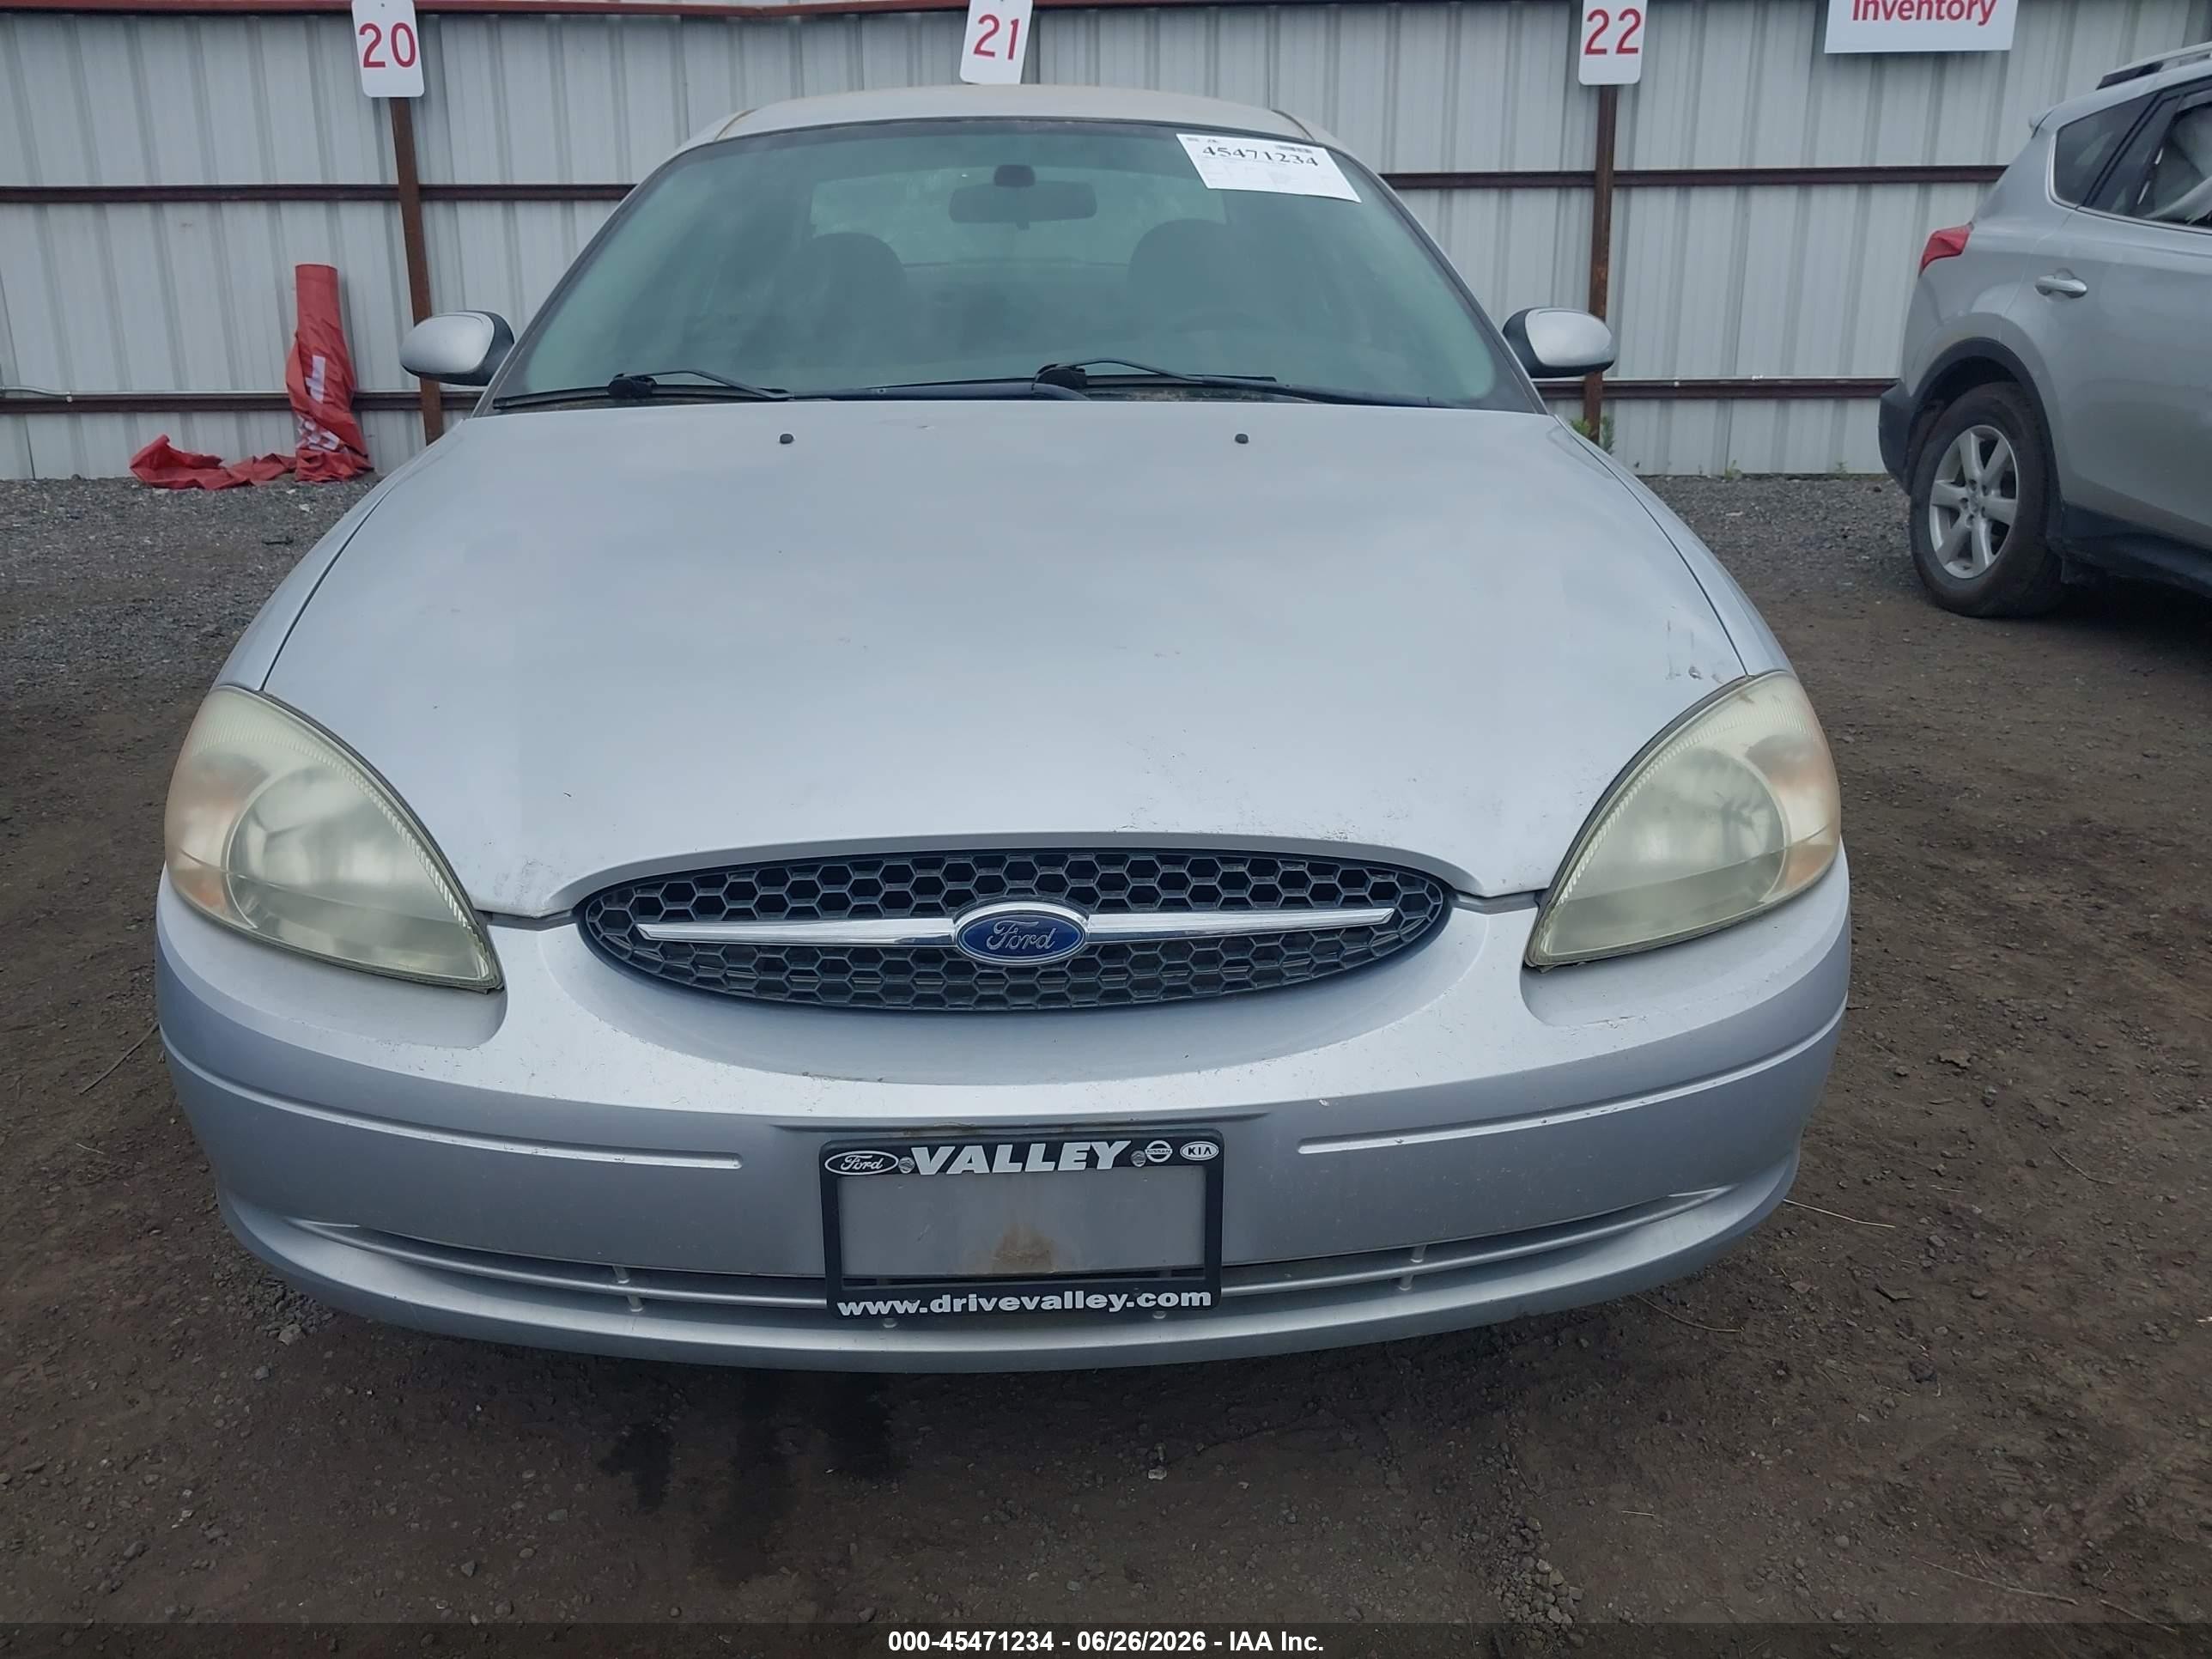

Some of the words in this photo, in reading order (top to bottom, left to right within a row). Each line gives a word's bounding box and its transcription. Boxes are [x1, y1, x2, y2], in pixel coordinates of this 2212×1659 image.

[1852, 0, 1997, 27] Inventory
[358, 22, 416, 68] 20
[973, 13, 1020, 61] 21
[1584, 8, 1641, 55] 22
[1202, 145, 1319, 167] 45471234
[986, 920, 1057, 951] Ford
[840, 1154, 884, 1171] Ford
[910, 1140, 1132, 1176] VALLEY
[1188, 1146, 1212, 1156] KIA
[837, 1290, 1212, 1316] www.drivevalley.com
